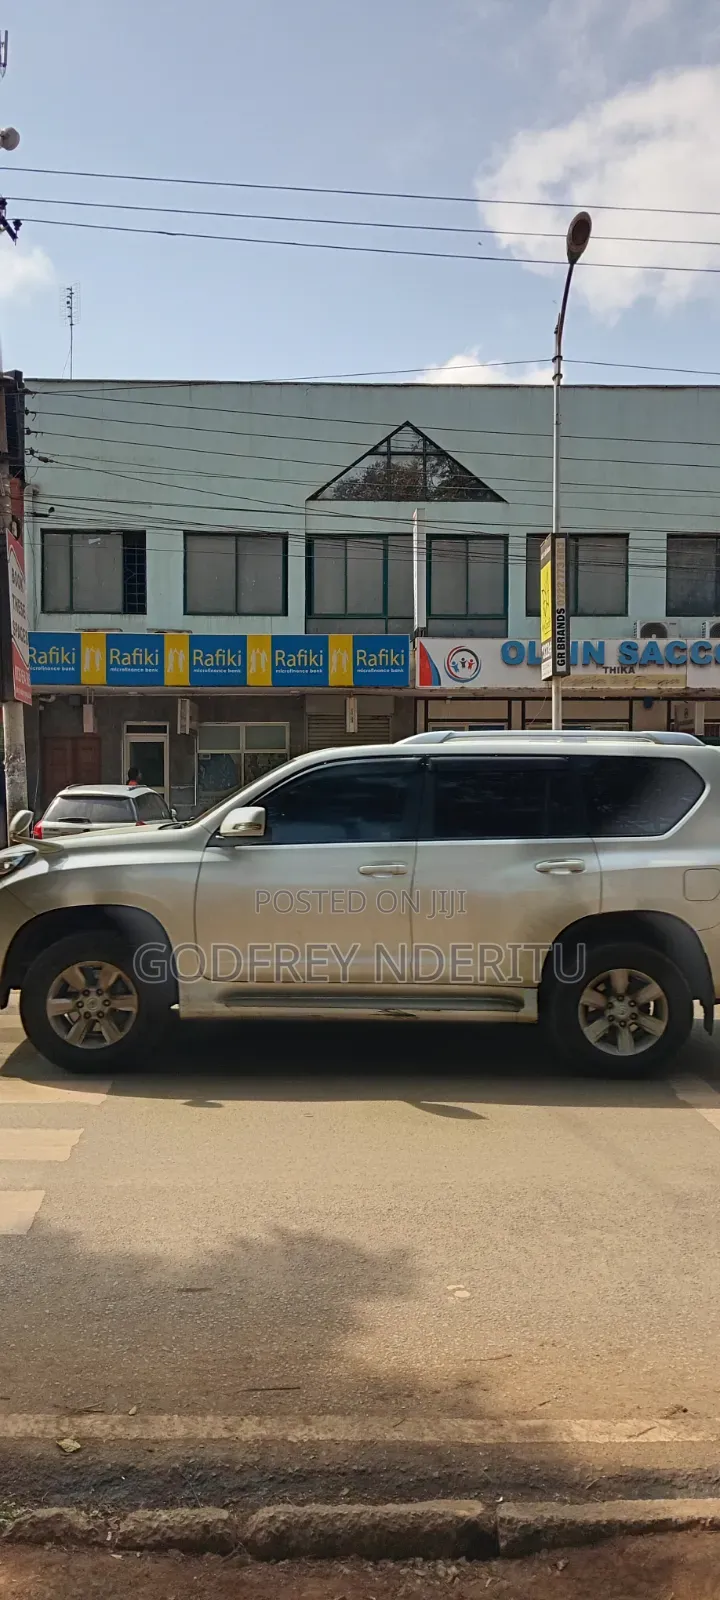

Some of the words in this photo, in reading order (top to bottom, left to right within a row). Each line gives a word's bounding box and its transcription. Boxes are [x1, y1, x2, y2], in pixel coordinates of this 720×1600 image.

[12, 592, 26, 619] THESE
[556, 608, 565, 651] BRANDS
[29, 646, 76, 664] Rafiki
[110, 648, 159, 666] Rafiki
[193, 648, 241, 666] Rafiki
[275, 648, 324, 667] Rafiki
[356, 648, 405, 666] Rafiki
[501, 640, 605, 666] OLIN
[618, 640, 720, 666] SACC
[556, 653, 565, 667] GR
[602, 666, 636, 675] THIKA
